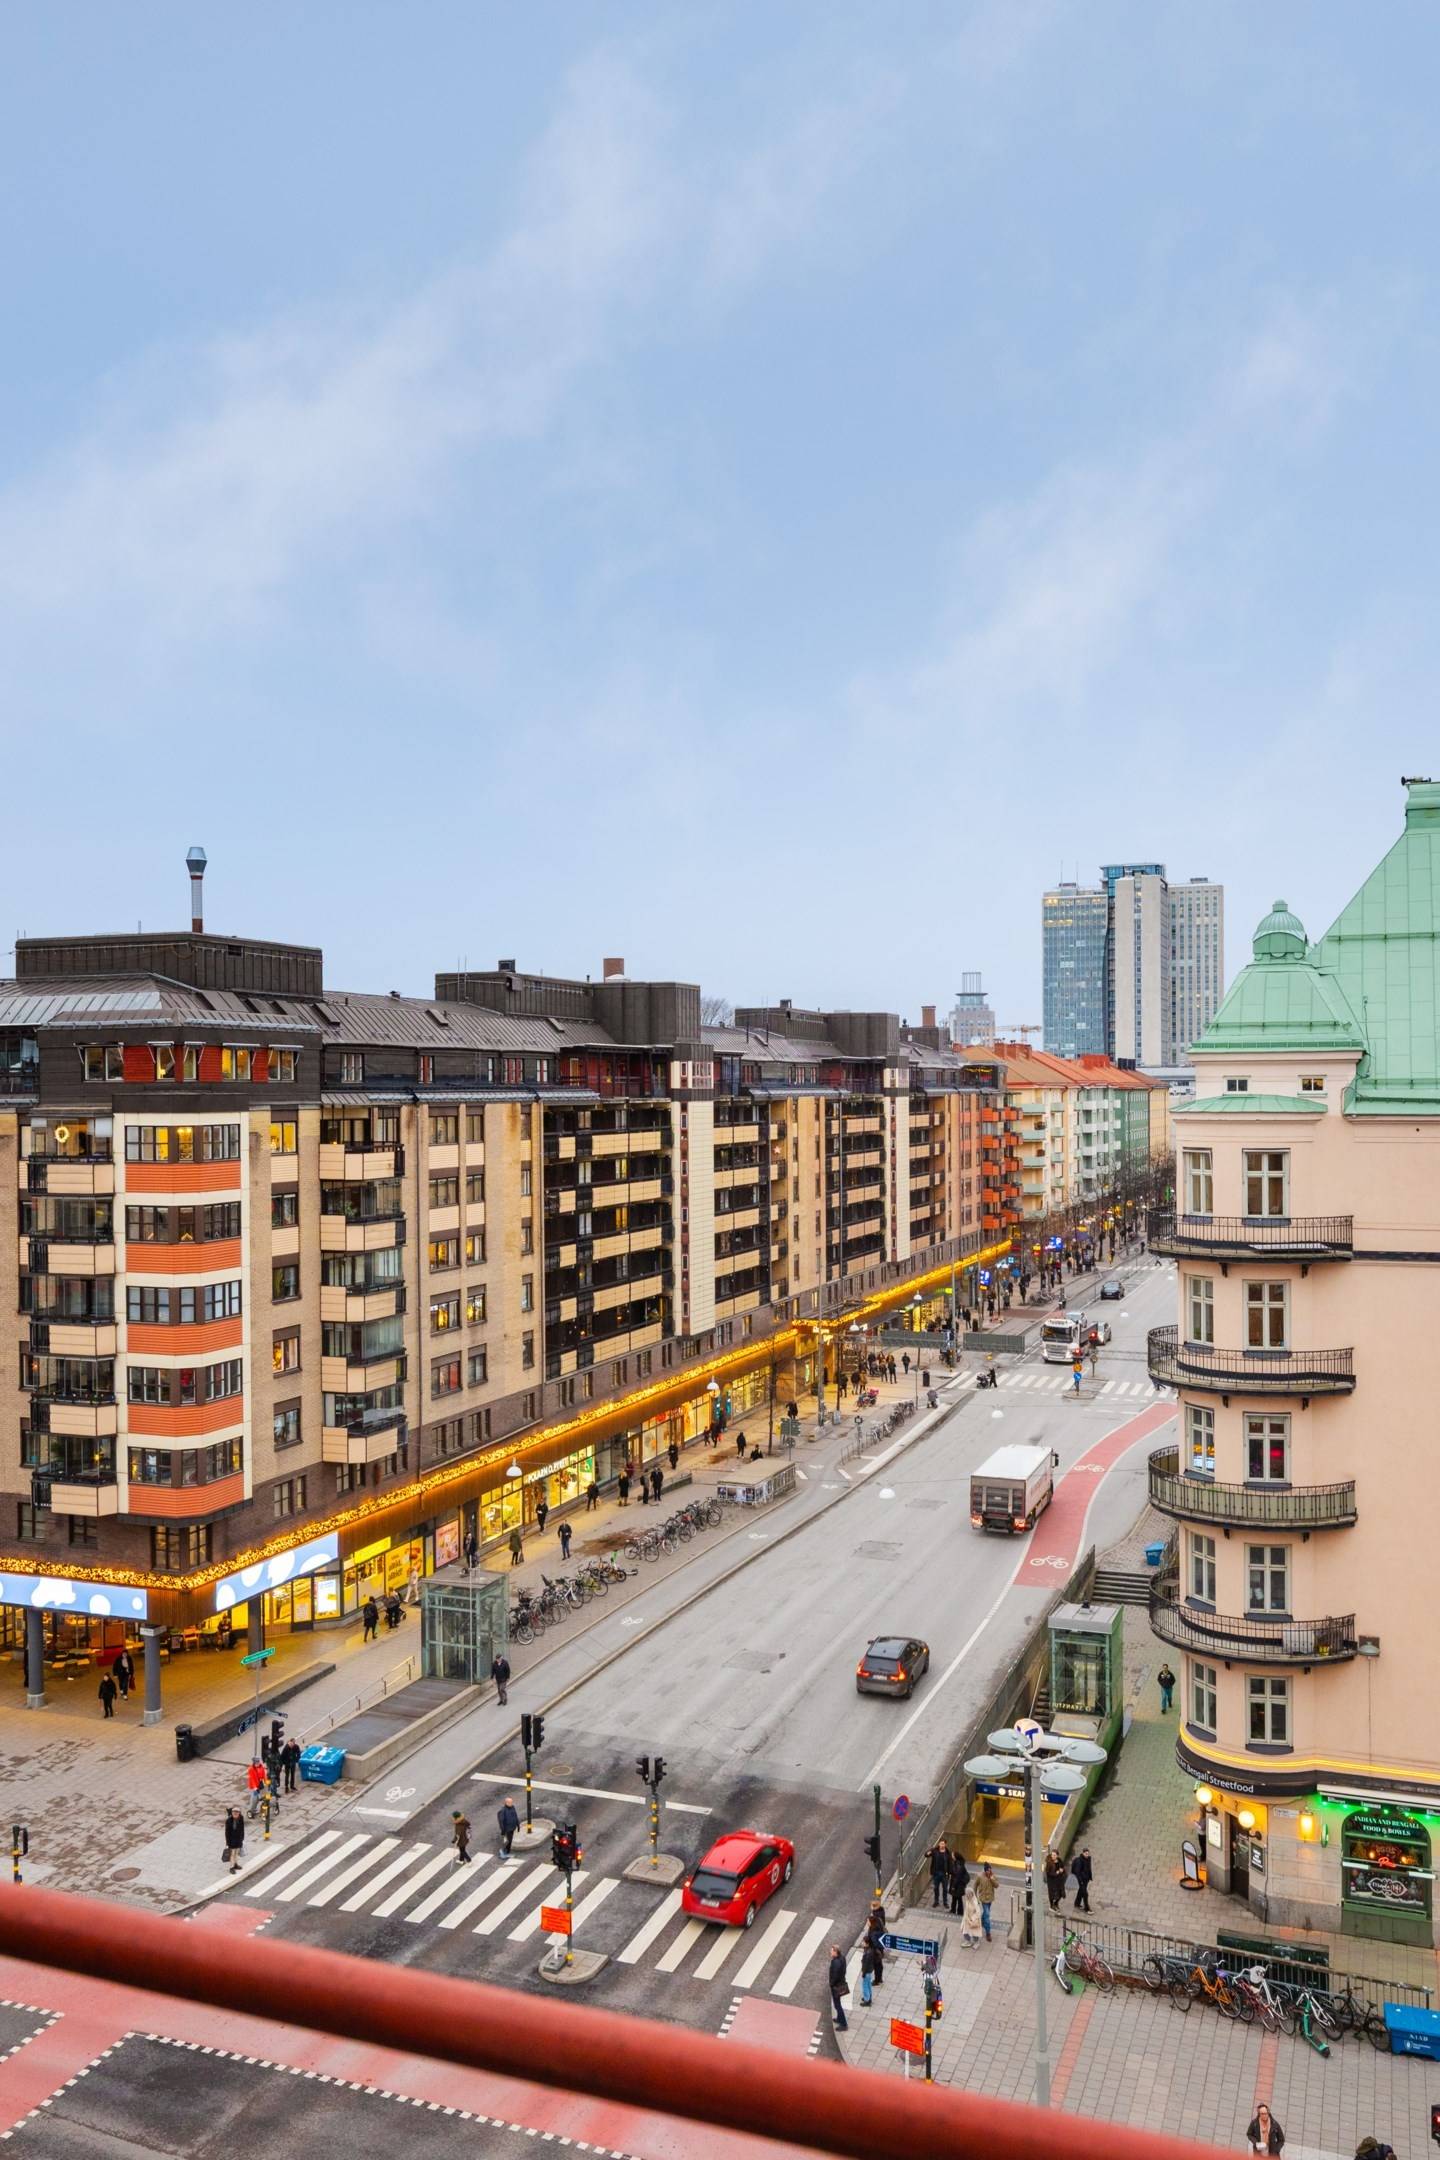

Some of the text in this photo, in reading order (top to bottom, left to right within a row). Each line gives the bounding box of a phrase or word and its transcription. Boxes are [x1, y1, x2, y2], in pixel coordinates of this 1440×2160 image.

[1187, 1763, 1254, 1793] Bengali Streetfood
[1354, 1815, 1379, 1825] INDIAN
[1379, 1818, 1392, 1826] AND
[1363, 1825, 1381, 1833] FOOD
[1388, 1827, 1411, 1836] BOWLS
